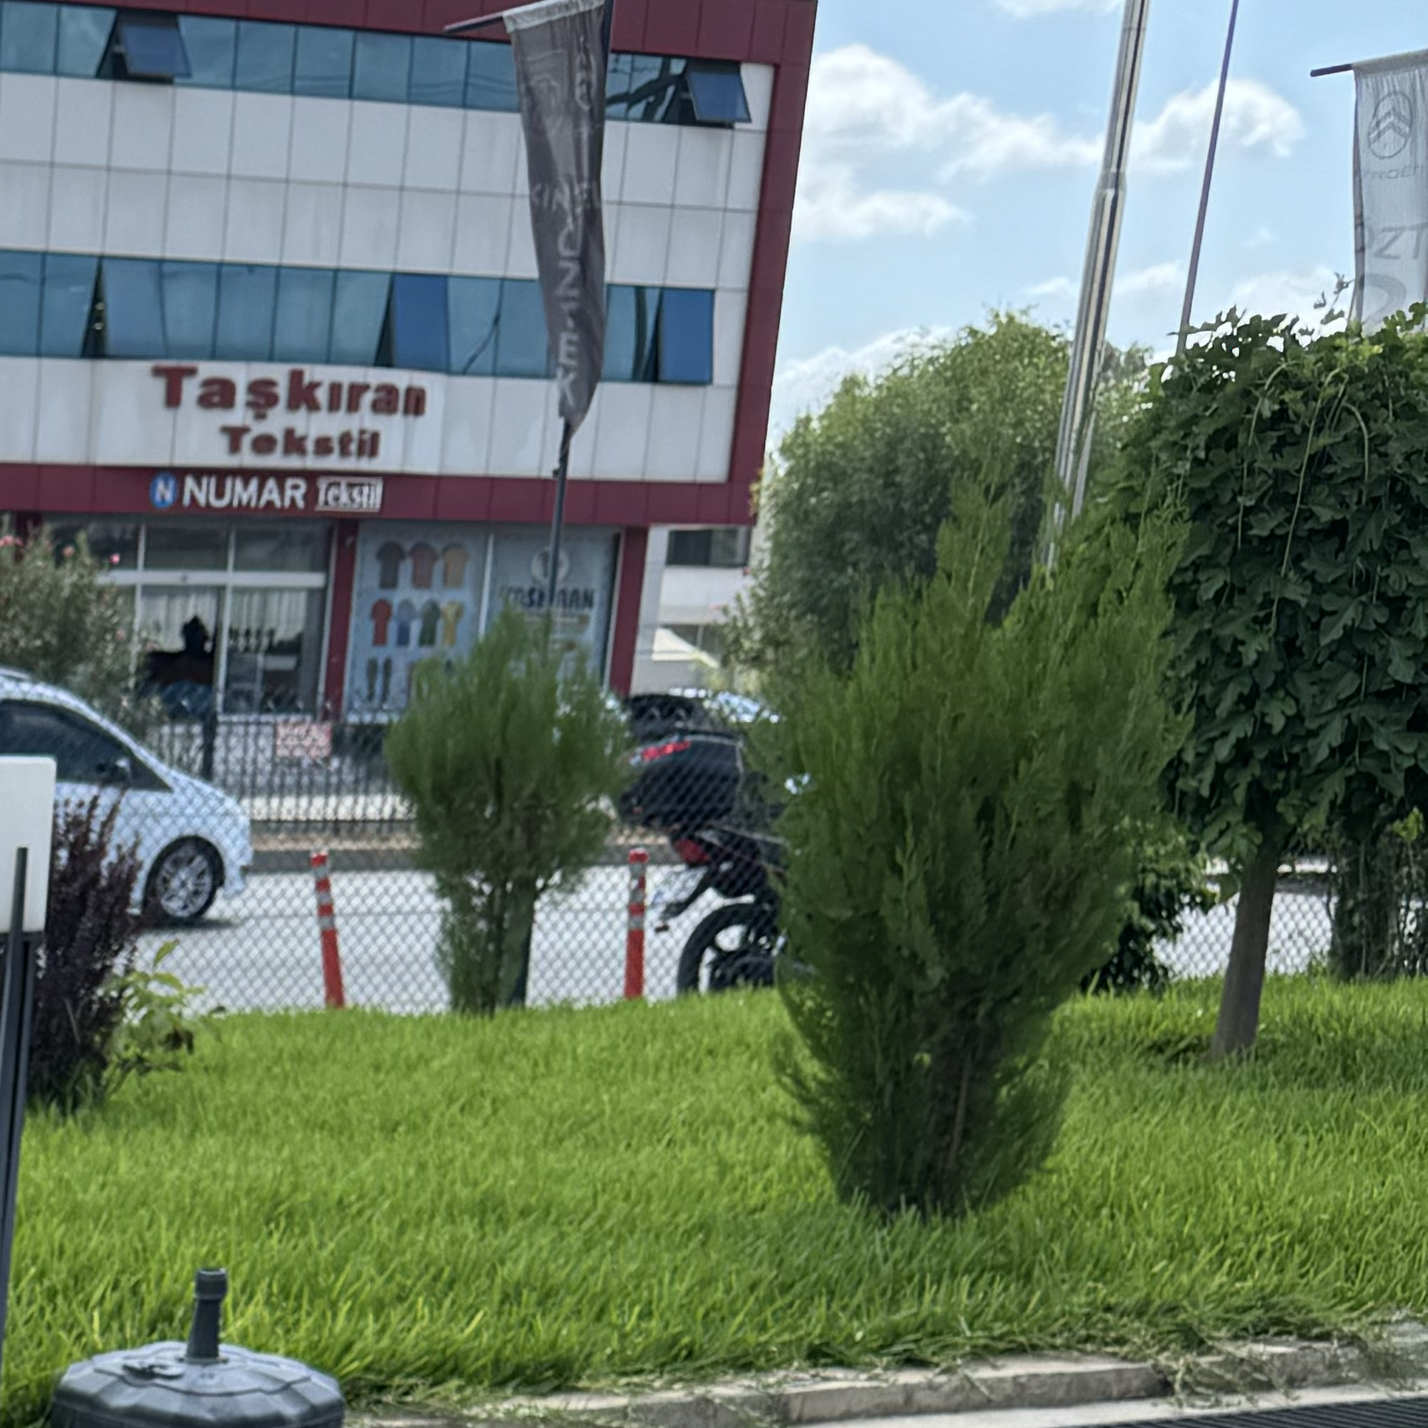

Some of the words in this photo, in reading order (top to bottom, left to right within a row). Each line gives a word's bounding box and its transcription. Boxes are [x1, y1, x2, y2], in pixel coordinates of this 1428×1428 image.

[152, 365, 427, 420] Taşkıran
[221, 426, 381, 459] Tekstil
[182, 474, 308, 511] NUMAR
